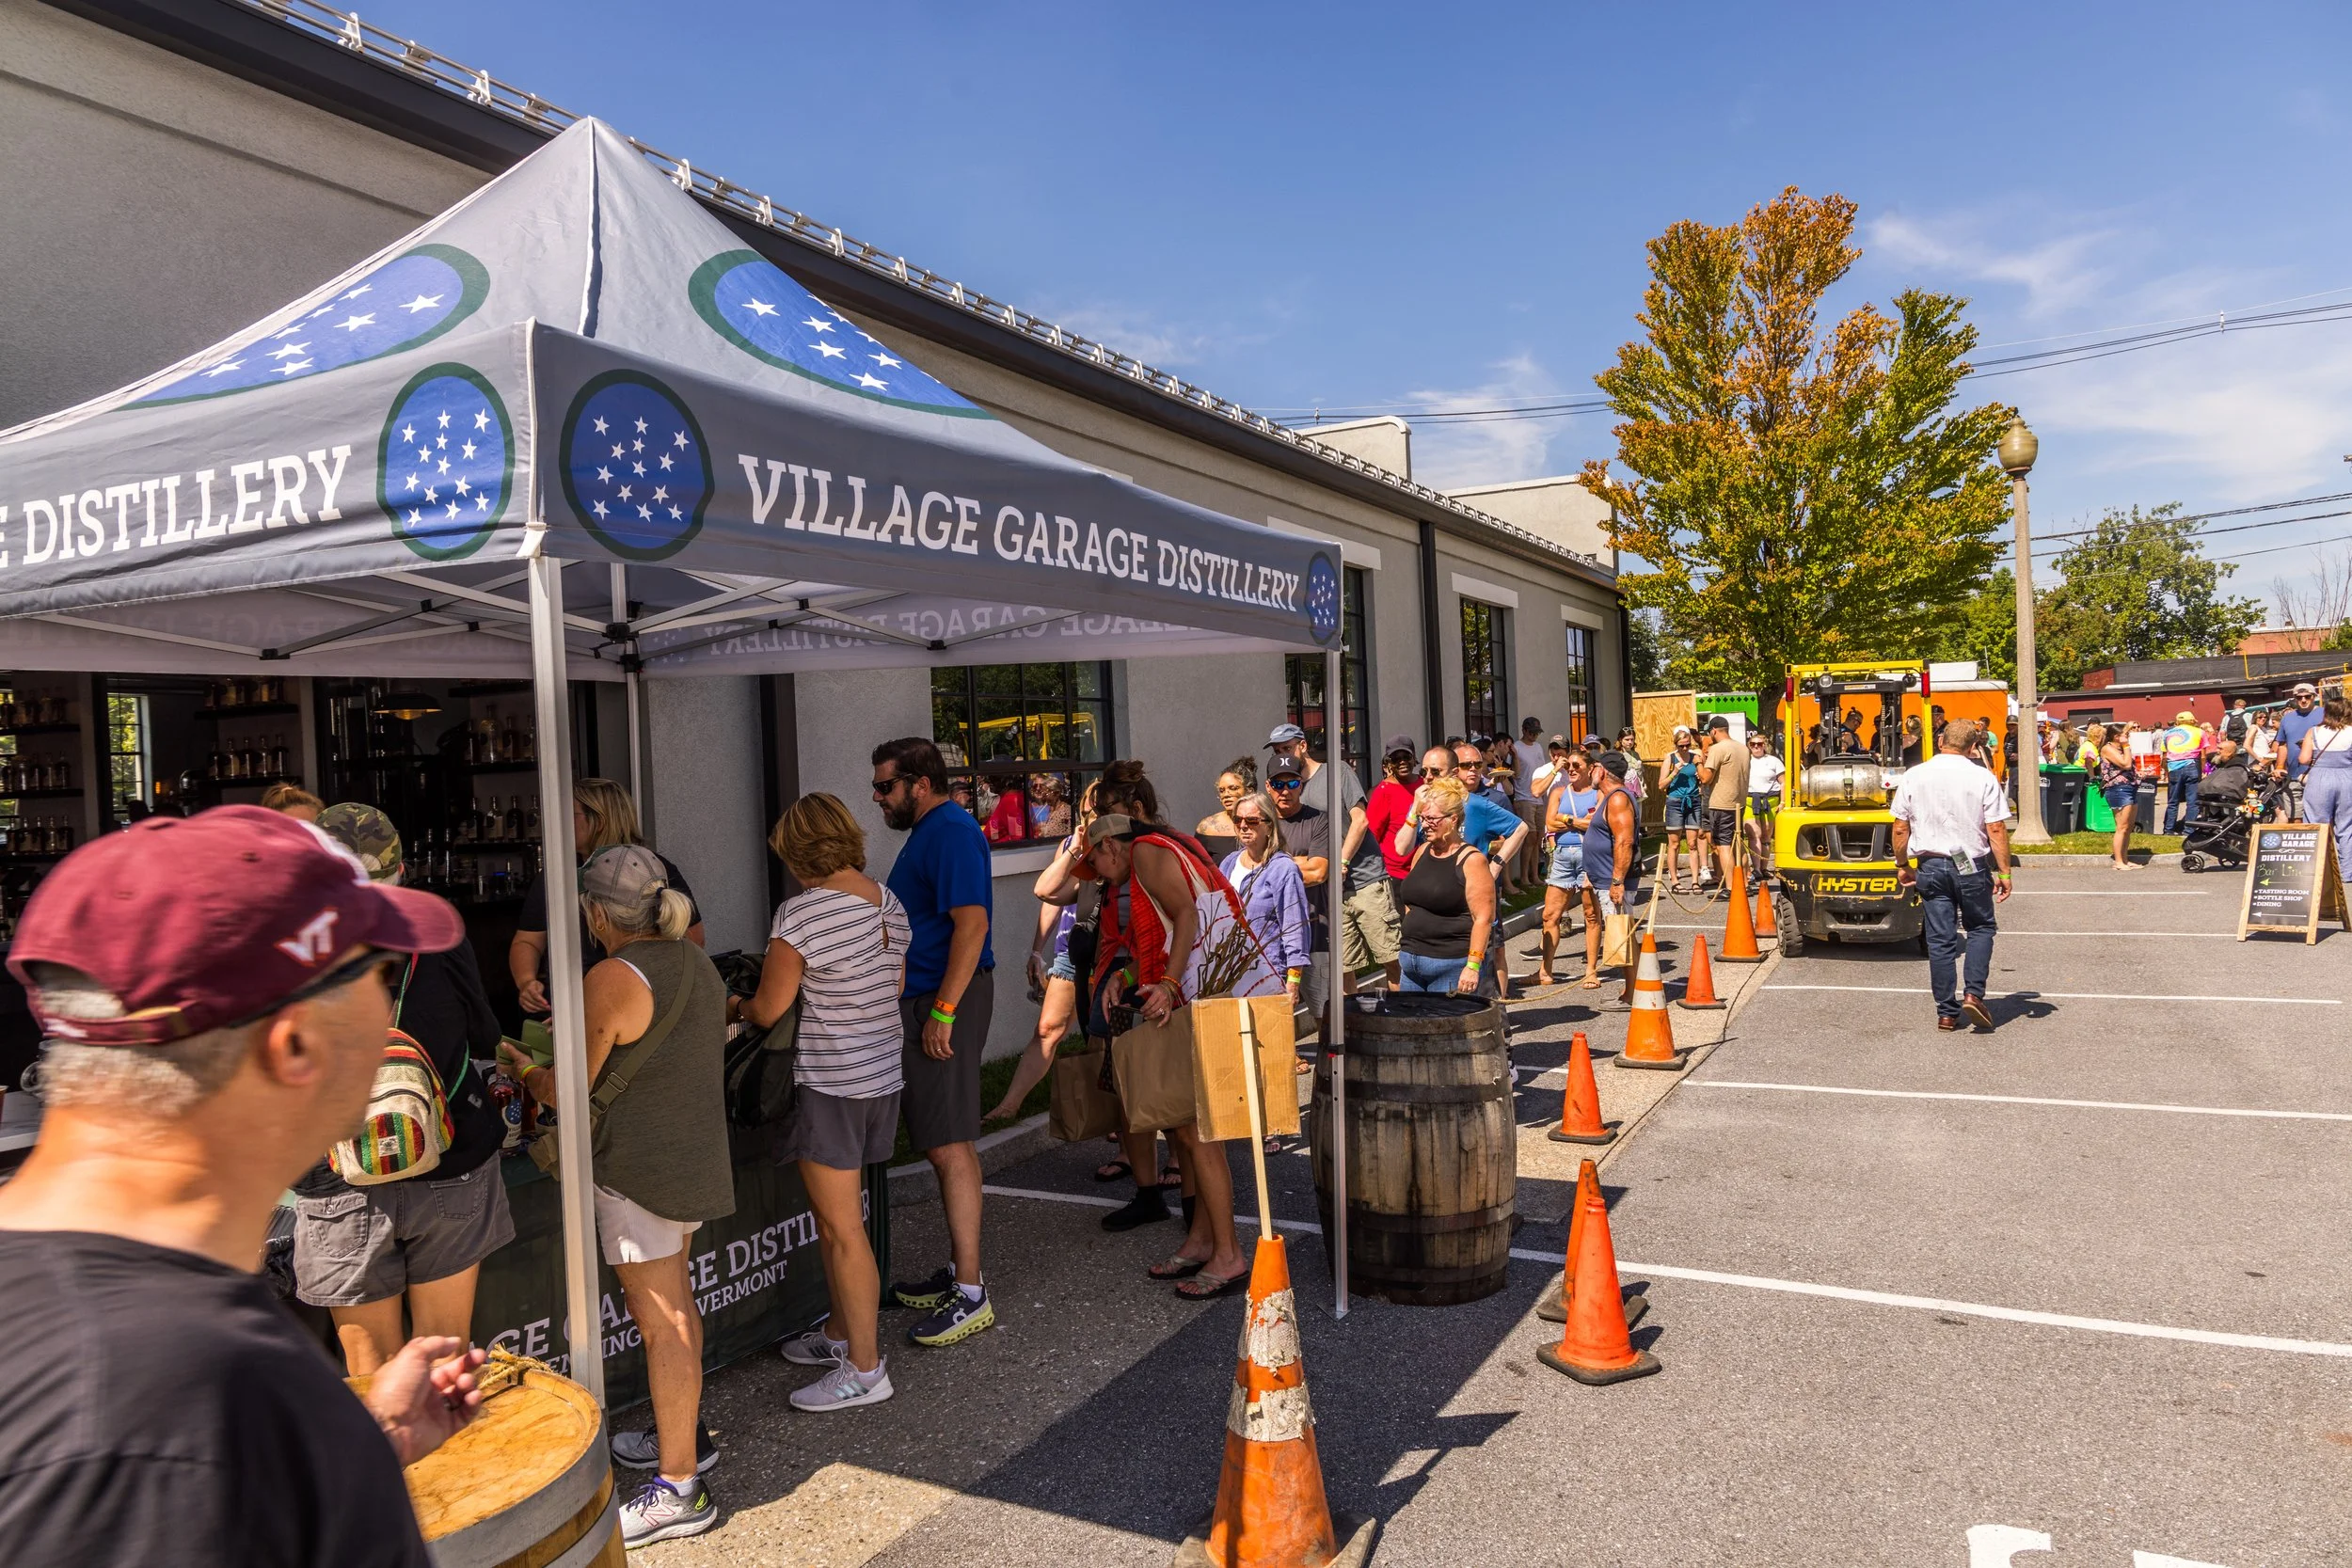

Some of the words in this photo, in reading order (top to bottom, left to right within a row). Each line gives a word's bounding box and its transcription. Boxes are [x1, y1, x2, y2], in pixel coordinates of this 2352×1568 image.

[23, 444, 352, 564] DISTILLERY
[738, 454, 980, 555] VILLAGE
[993, 505, 1149, 583] GARAGE
[1157, 539, 1299, 612] DISTILLERY
[1818, 878, 1898, 892] HYSTER
[695, 1259, 787, 1317] VERMONT
